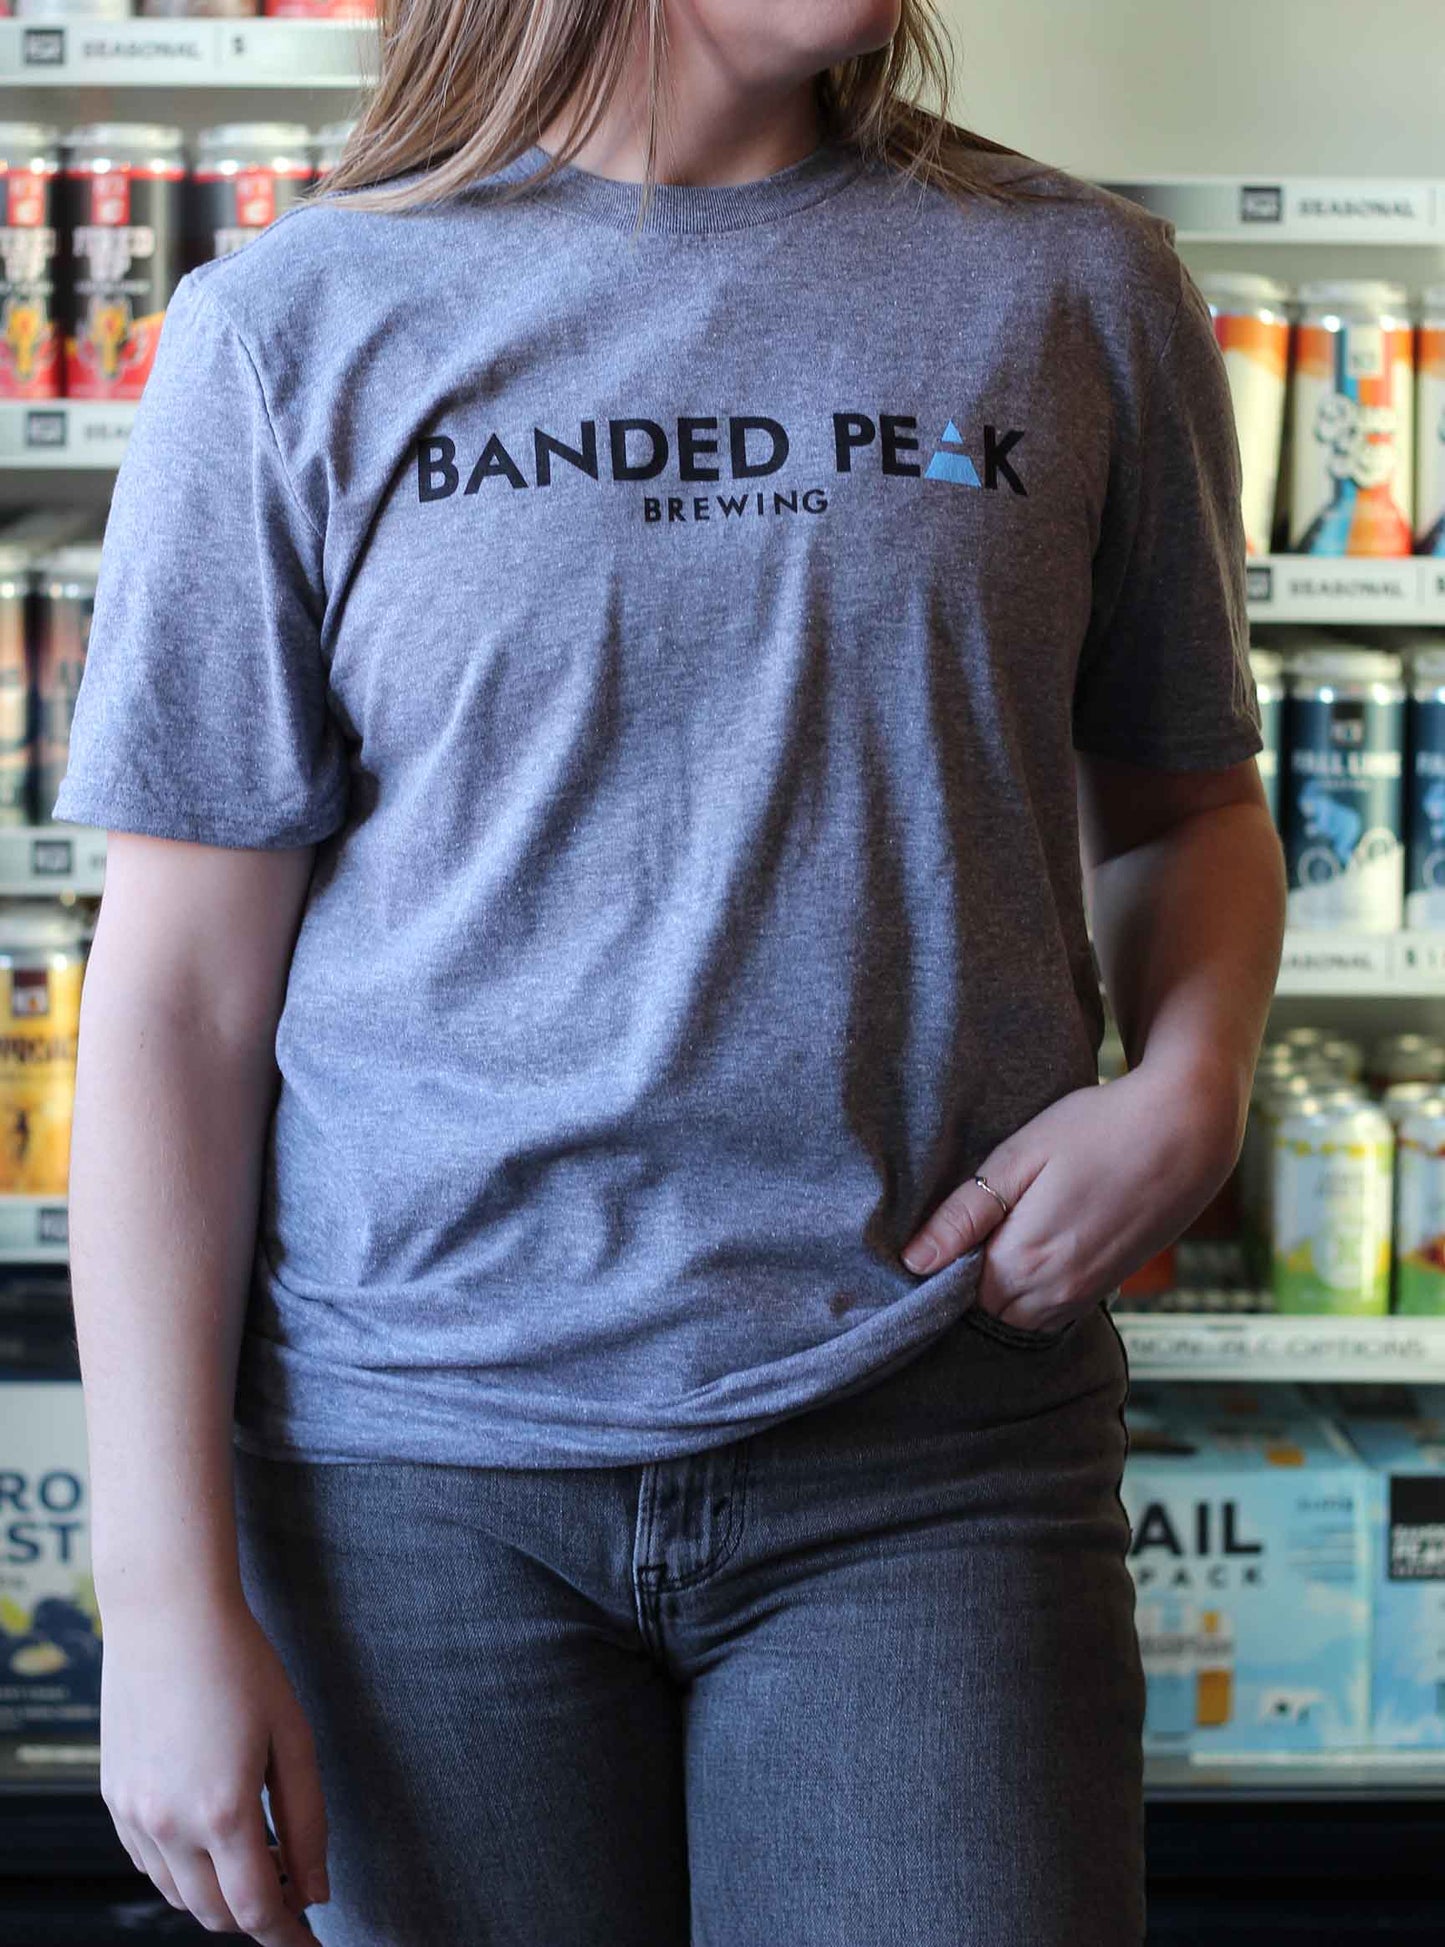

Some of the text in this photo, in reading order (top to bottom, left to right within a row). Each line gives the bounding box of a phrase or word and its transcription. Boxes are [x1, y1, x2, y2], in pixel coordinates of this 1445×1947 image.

[417, 413, 1028, 503] BANDED PEAK
[644, 489, 828, 522] BREWING
[1130, 1501, 1262, 1556] AIL
[1138, 1567, 1262, 1589] PACK
